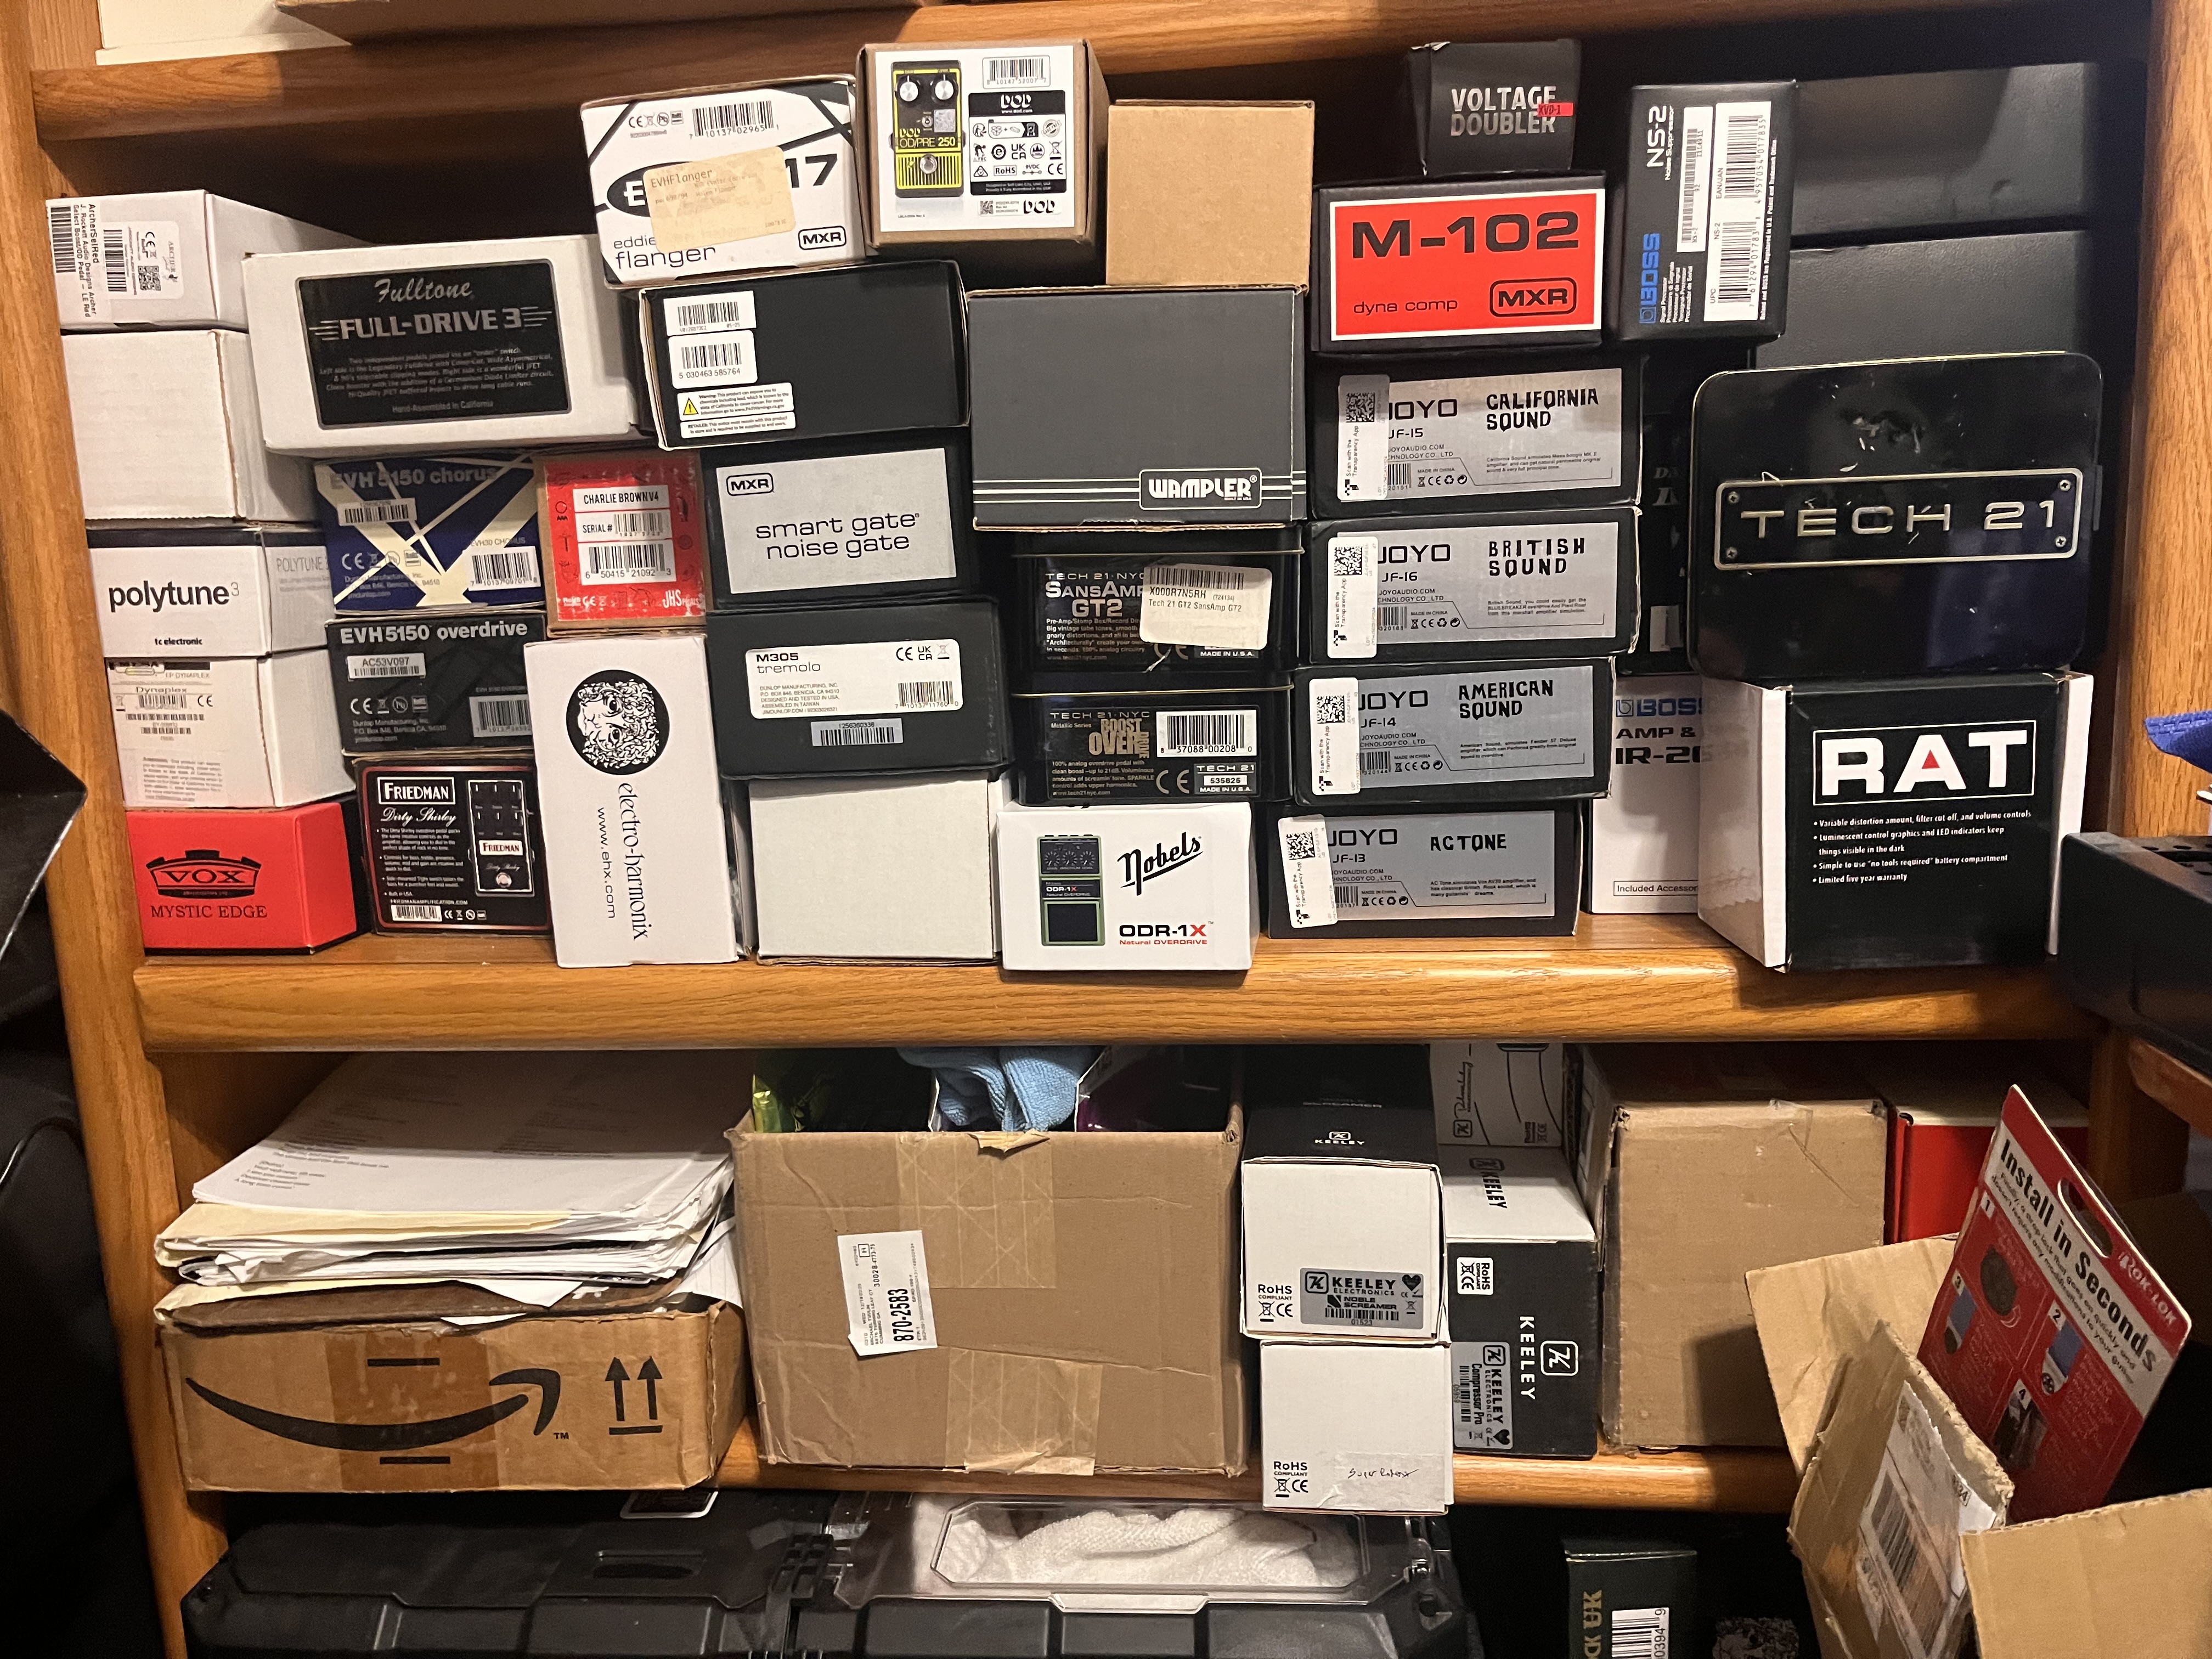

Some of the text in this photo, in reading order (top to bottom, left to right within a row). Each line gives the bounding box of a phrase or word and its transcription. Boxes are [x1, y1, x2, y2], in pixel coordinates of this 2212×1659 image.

[1451, 86, 1556, 111] VOLTAGE
[1451, 111, 1556, 136] DOUBLER
[900, 137, 956, 148] OD/PRE 250
[1647, 105, 1667, 167] NS-2
[651, 170, 713, 188] EVHFlanger
[1716, 167, 1724, 199] EAN/JAN
[88, 204, 100, 264] ArcherSelRed
[613, 235, 656, 250] eddie
[803, 232, 842, 245] MXR
[1352, 211, 1579, 258] M-102
[616, 246, 716, 269] flanger
[1640, 233, 1660, 306] BOSS
[374, 277, 473, 303] Fulltone
[1498, 287, 1568, 308] MXR
[1353, 299, 1458, 317] dyna comp
[340, 308, 522, 340] FULL-DRIVE 3
[686, 368, 741, 379] 030463 585764
[1486, 388, 1599, 411] CALIFORNIA
[1487, 410, 1551, 431] SOUND
[430, 467, 497, 484] chorus
[730, 478, 769, 491] MXR
[1148, 478, 1251, 499] WAMPLER
[584, 491, 659, 505] CHARLIE BROWN V4
[583, 525, 606, 533] SERIAL
[755, 517, 843, 539] smart
[1740, 500, 2055, 540] TECH 21
[766, 535, 910, 560] noise gate
[1378, 544, 1451, 565] JOYO
[1488, 537, 1585, 557] BRITISH
[276, 556, 324, 572] POLYTUNE
[601, 568, 656, 578] 50415 21092
[1488, 557, 1567, 578] SOUND
[1045, 572, 1088, 580] TECH
[1381, 571, 1418, 583] JF-16
[662, 589, 682, 608] JHS
[1149, 586, 1206, 600] X000R7N5RH
[1072, 599, 1122, 617] GT2
[1149, 599, 1165, 608] Tech
[1178, 601, 1192, 609] GT2
[1193, 602, 1226, 612] SansAmp
[1228, 605, 1242, 613] GT2
[340, 620, 528, 644] EVH 5150 overdrive
[757, 652, 799, 663] M305
[757, 662, 821, 675] tremolo
[1459, 679, 1554, 701] AMERICAN
[1358, 690, 1429, 711] JOYO
[1459, 700, 1523, 721] SOUND
[1101, 718, 1143, 734] BOOST
[1361, 717, 1396, 729] JF-14
[1616, 727, 1696, 739] AMP &
[1088, 731, 1138, 755] OVER
[1176, 744, 1237, 753] 37088 00208
[1821, 730, 2028, 796] RAT
[384, 782, 449, 800] FRIEDMAN
[380, 806, 457, 827] Dirty Shirley
[1819, 819, 1848, 827] Variable
[1850, 817, 1883, 826] distortion
[1916, 815, 1933, 823] filter
[1975, 811, 2002, 820] volume
[2003, 810, 2032, 819] controls
[1328, 829, 1398, 847] JOYO
[1819, 825, 2005, 842] Luminescent control graphics LED indicators keep
[482, 842, 520, 852] FRIEDMAN
[1819, 848, 1841, 857] things
[1842, 846, 1865, 855] visible
[596, 806, 616, 919] www.ehx.com
[617, 782, 653, 942] electro-harmonix
[1117, 832, 1203, 896] Nobels
[1333, 854, 1365, 864] JF-13
[1819, 854, 2008, 870] Simple battery compartment
[160, 868, 246, 884] VOX
[1818, 873, 1908, 885] Limited warranty
[1617, 884, 1654, 893] Included
[151, 905, 268, 918] MYSTIC EDGE
[1119, 924, 1207, 937] ODR-1X
[2000, 1138, 2055, 1227] Install
[2053, 1218, 2072, 1258] in
[2075, 1251, 2157, 1372] Seconds
[1481, 1262, 1491, 1290] RoHS
[1258, 1277, 1396, 1295] RoHS KEELEY
[887, 1289, 915, 1342] 870-2583
[1520, 1316, 1536, 1400] KEELEY
[1471, 1363, 1485, 1425] Compressor Pro
[1491, 1369, 1504, 1424] KEELEY
[1273, 1461, 1308, 1471] RoHS
